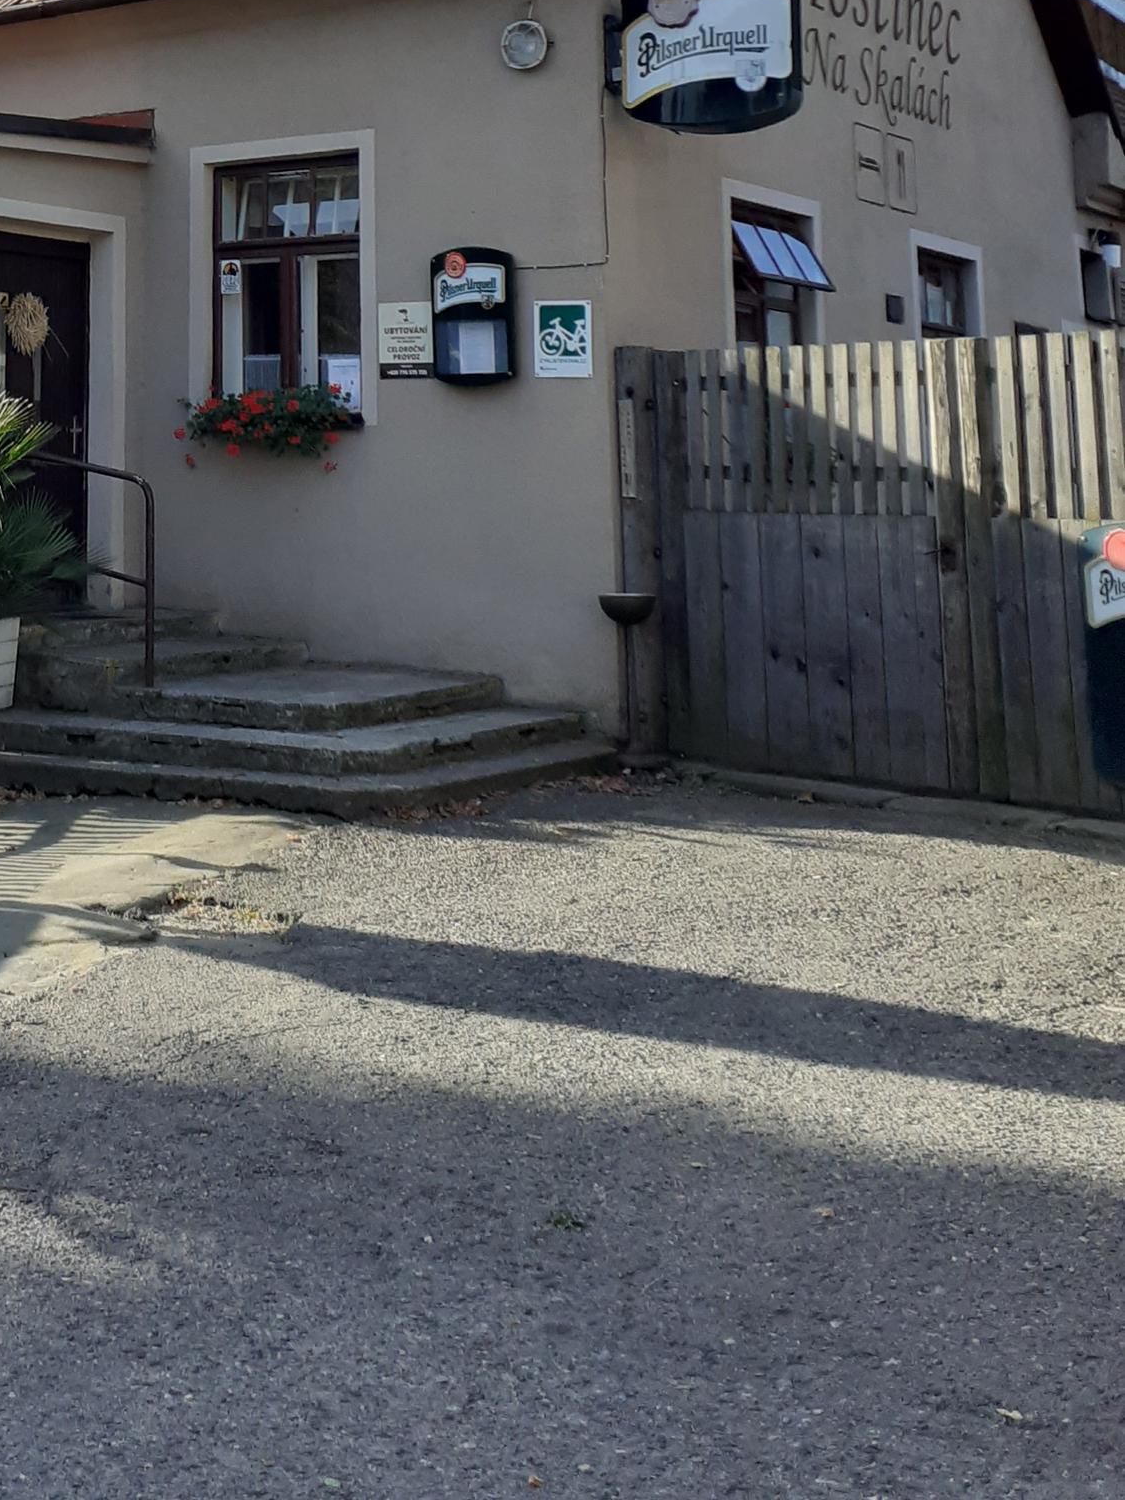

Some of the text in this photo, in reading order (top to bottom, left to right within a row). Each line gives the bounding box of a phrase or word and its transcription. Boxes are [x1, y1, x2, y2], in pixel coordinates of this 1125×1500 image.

[637, 23, 769, 79] Pilsner Urquell
[801, 27, 952, 131] Na Skalách
[383, 324, 428, 335] UBYTOVÁNÍ
[1099, 569, 1125, 605] Pils
